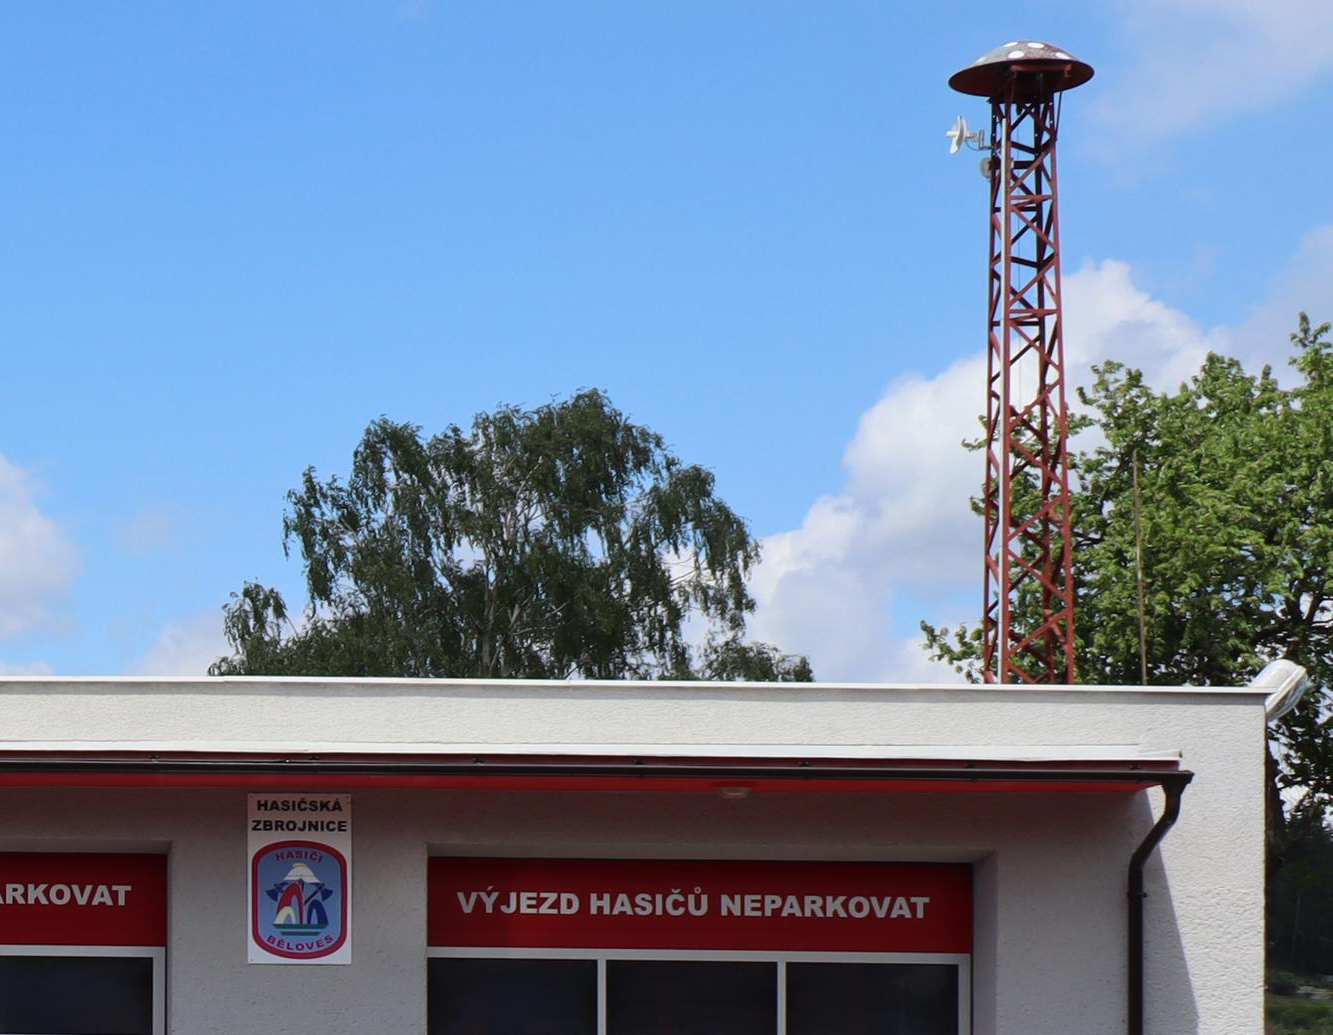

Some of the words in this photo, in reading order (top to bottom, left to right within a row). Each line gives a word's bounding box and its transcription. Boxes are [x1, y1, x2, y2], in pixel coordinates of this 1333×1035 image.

[257, 798, 343, 812] HASIČSKÁ
[251, 819, 348, 832] ZBROJNICE
[457, 885, 580, 915] VÝJEZD
[589, 886, 709, 916] HASIČŮ
[720, 894, 930, 919] NEPARKOVAT
